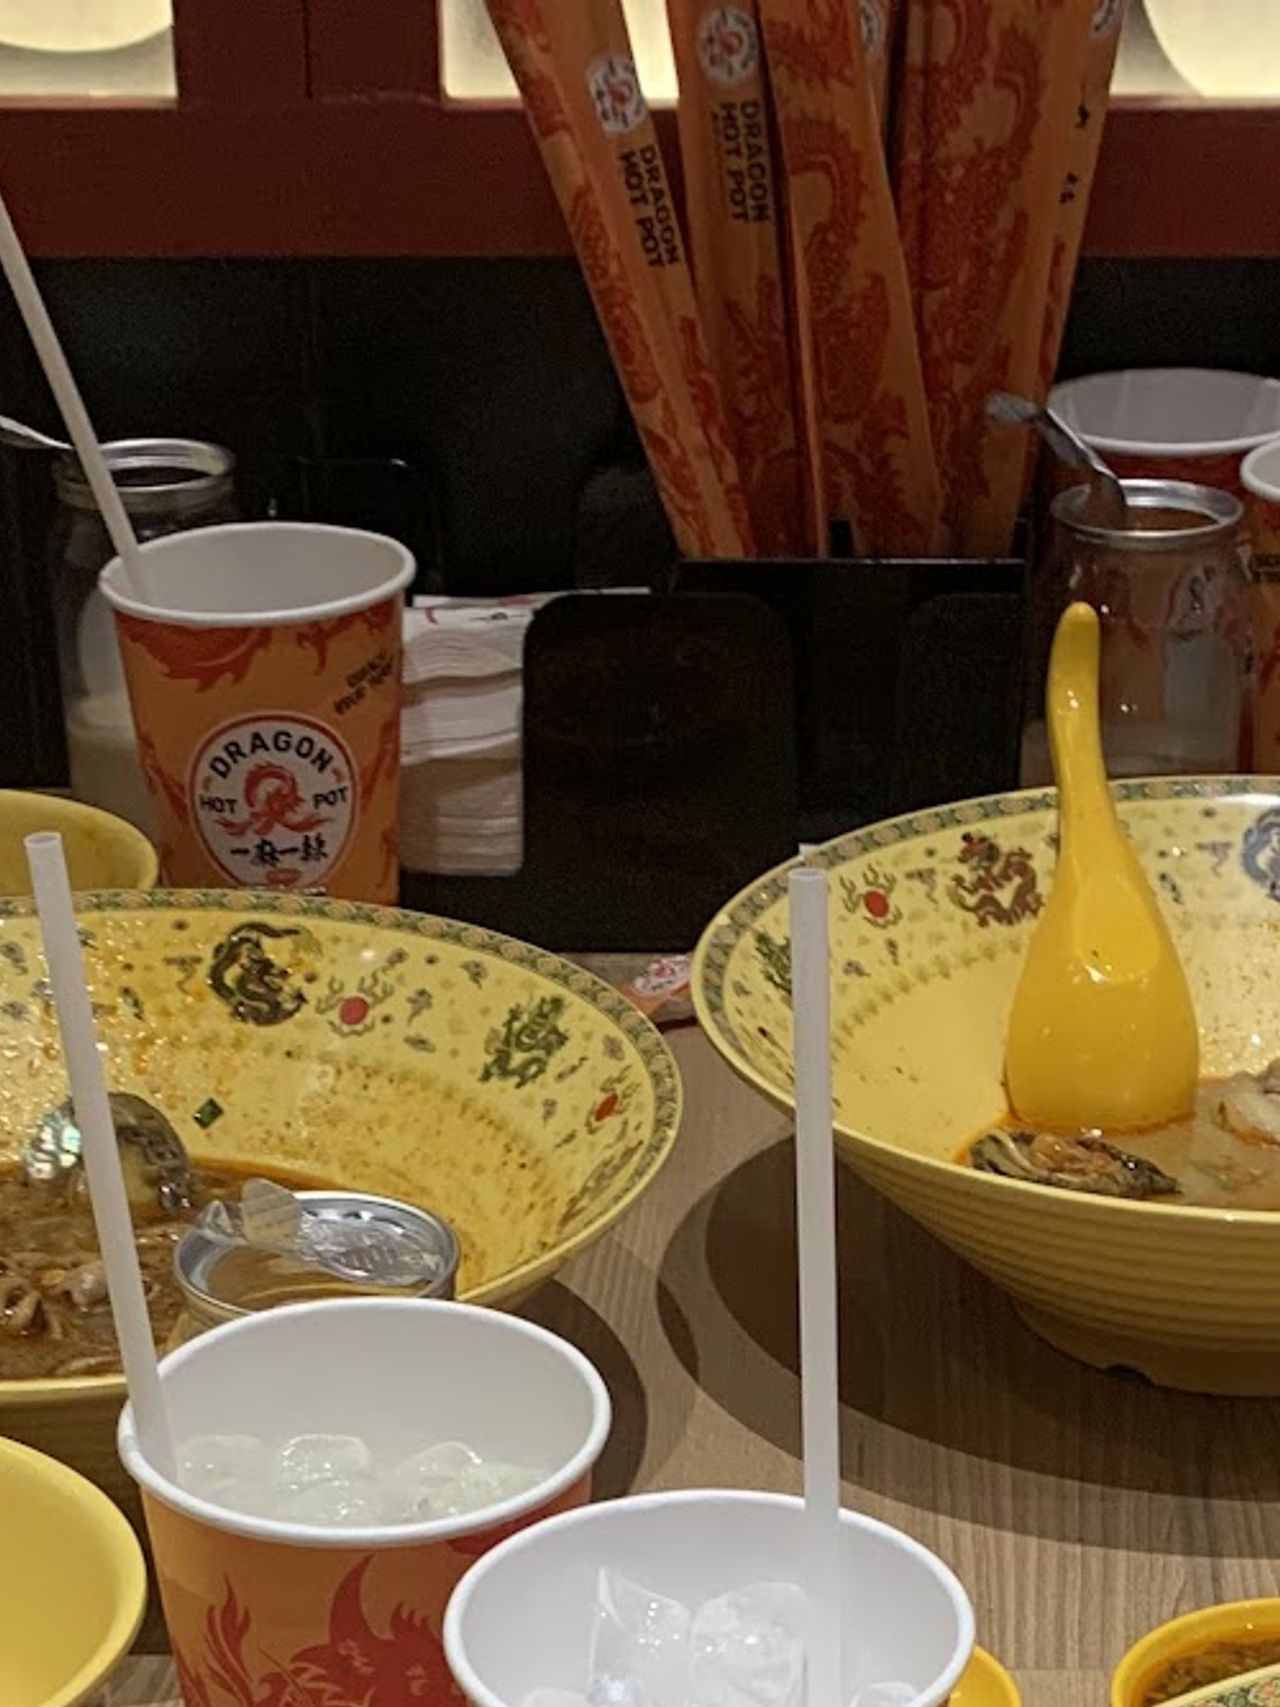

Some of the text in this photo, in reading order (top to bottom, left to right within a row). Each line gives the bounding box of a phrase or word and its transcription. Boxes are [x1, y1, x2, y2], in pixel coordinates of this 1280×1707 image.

[620, 150, 667, 268] HOT POT
[639, 144, 681, 266] DRAGON
[721, 102, 750, 223] HOT POT
[740, 101, 770, 223] DRAGON
[199, 786, 350, 815] HOT POT
[209, 730, 335, 780] DRAGON
